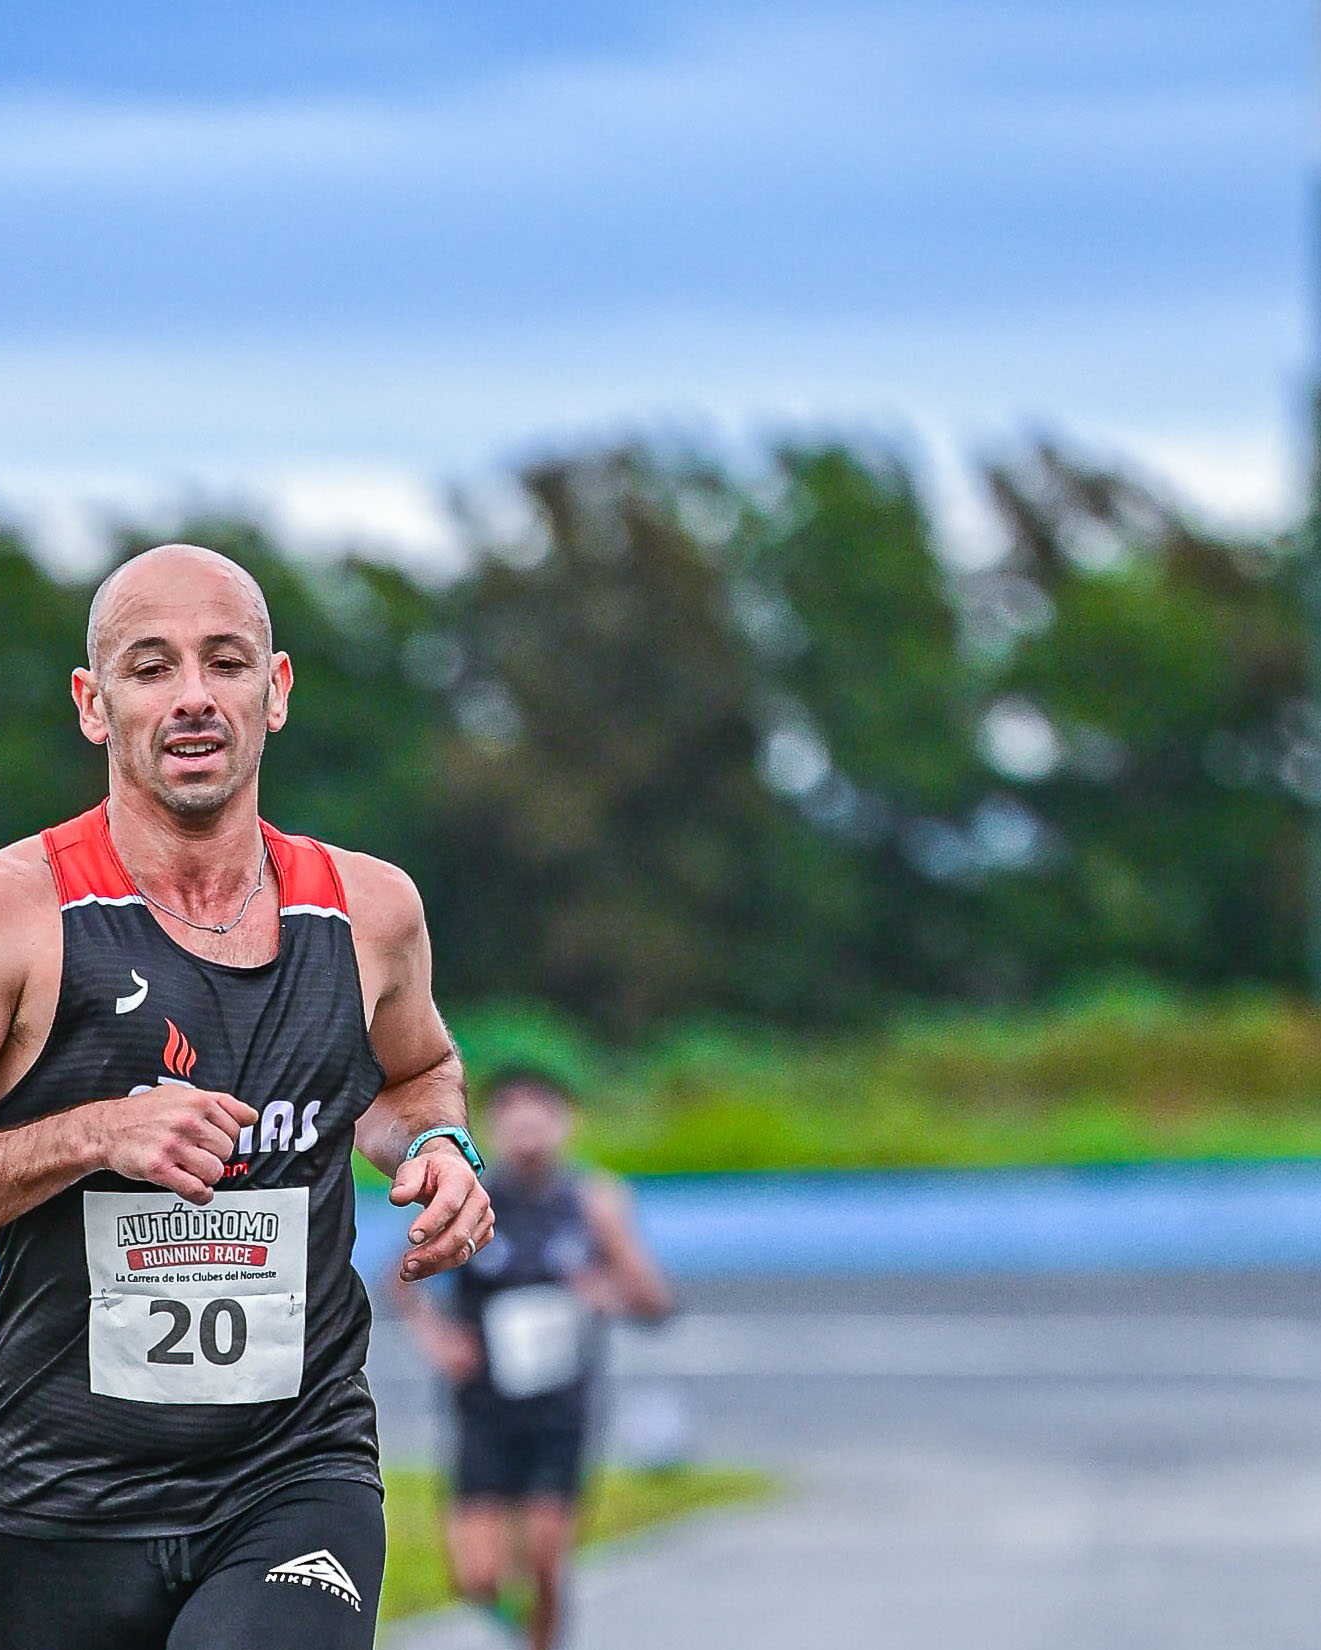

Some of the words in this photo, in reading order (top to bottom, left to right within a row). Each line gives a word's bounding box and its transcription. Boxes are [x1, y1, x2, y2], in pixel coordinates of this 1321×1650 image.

[117, 1203, 279, 1247] AUTÓDROMO
[115, 1273, 126, 1283] La
[127, 1273, 160, 1283] Carrera
[162, 1273, 175, 1283] de
[176, 1273, 191, 1283] los
[192, 1271, 223, 1282] Clubes
[225, 1271, 239, 1281] del
[240, 1270, 277, 1280] Noroeste
[142, 1246, 210, 1267] RUNNING
[214, 1246, 253, 1264] RACE
[147, 1299, 247, 1366] 20
[264, 1573, 312, 1587] NIKE
[320, 1581, 362, 1613] TRAIL
